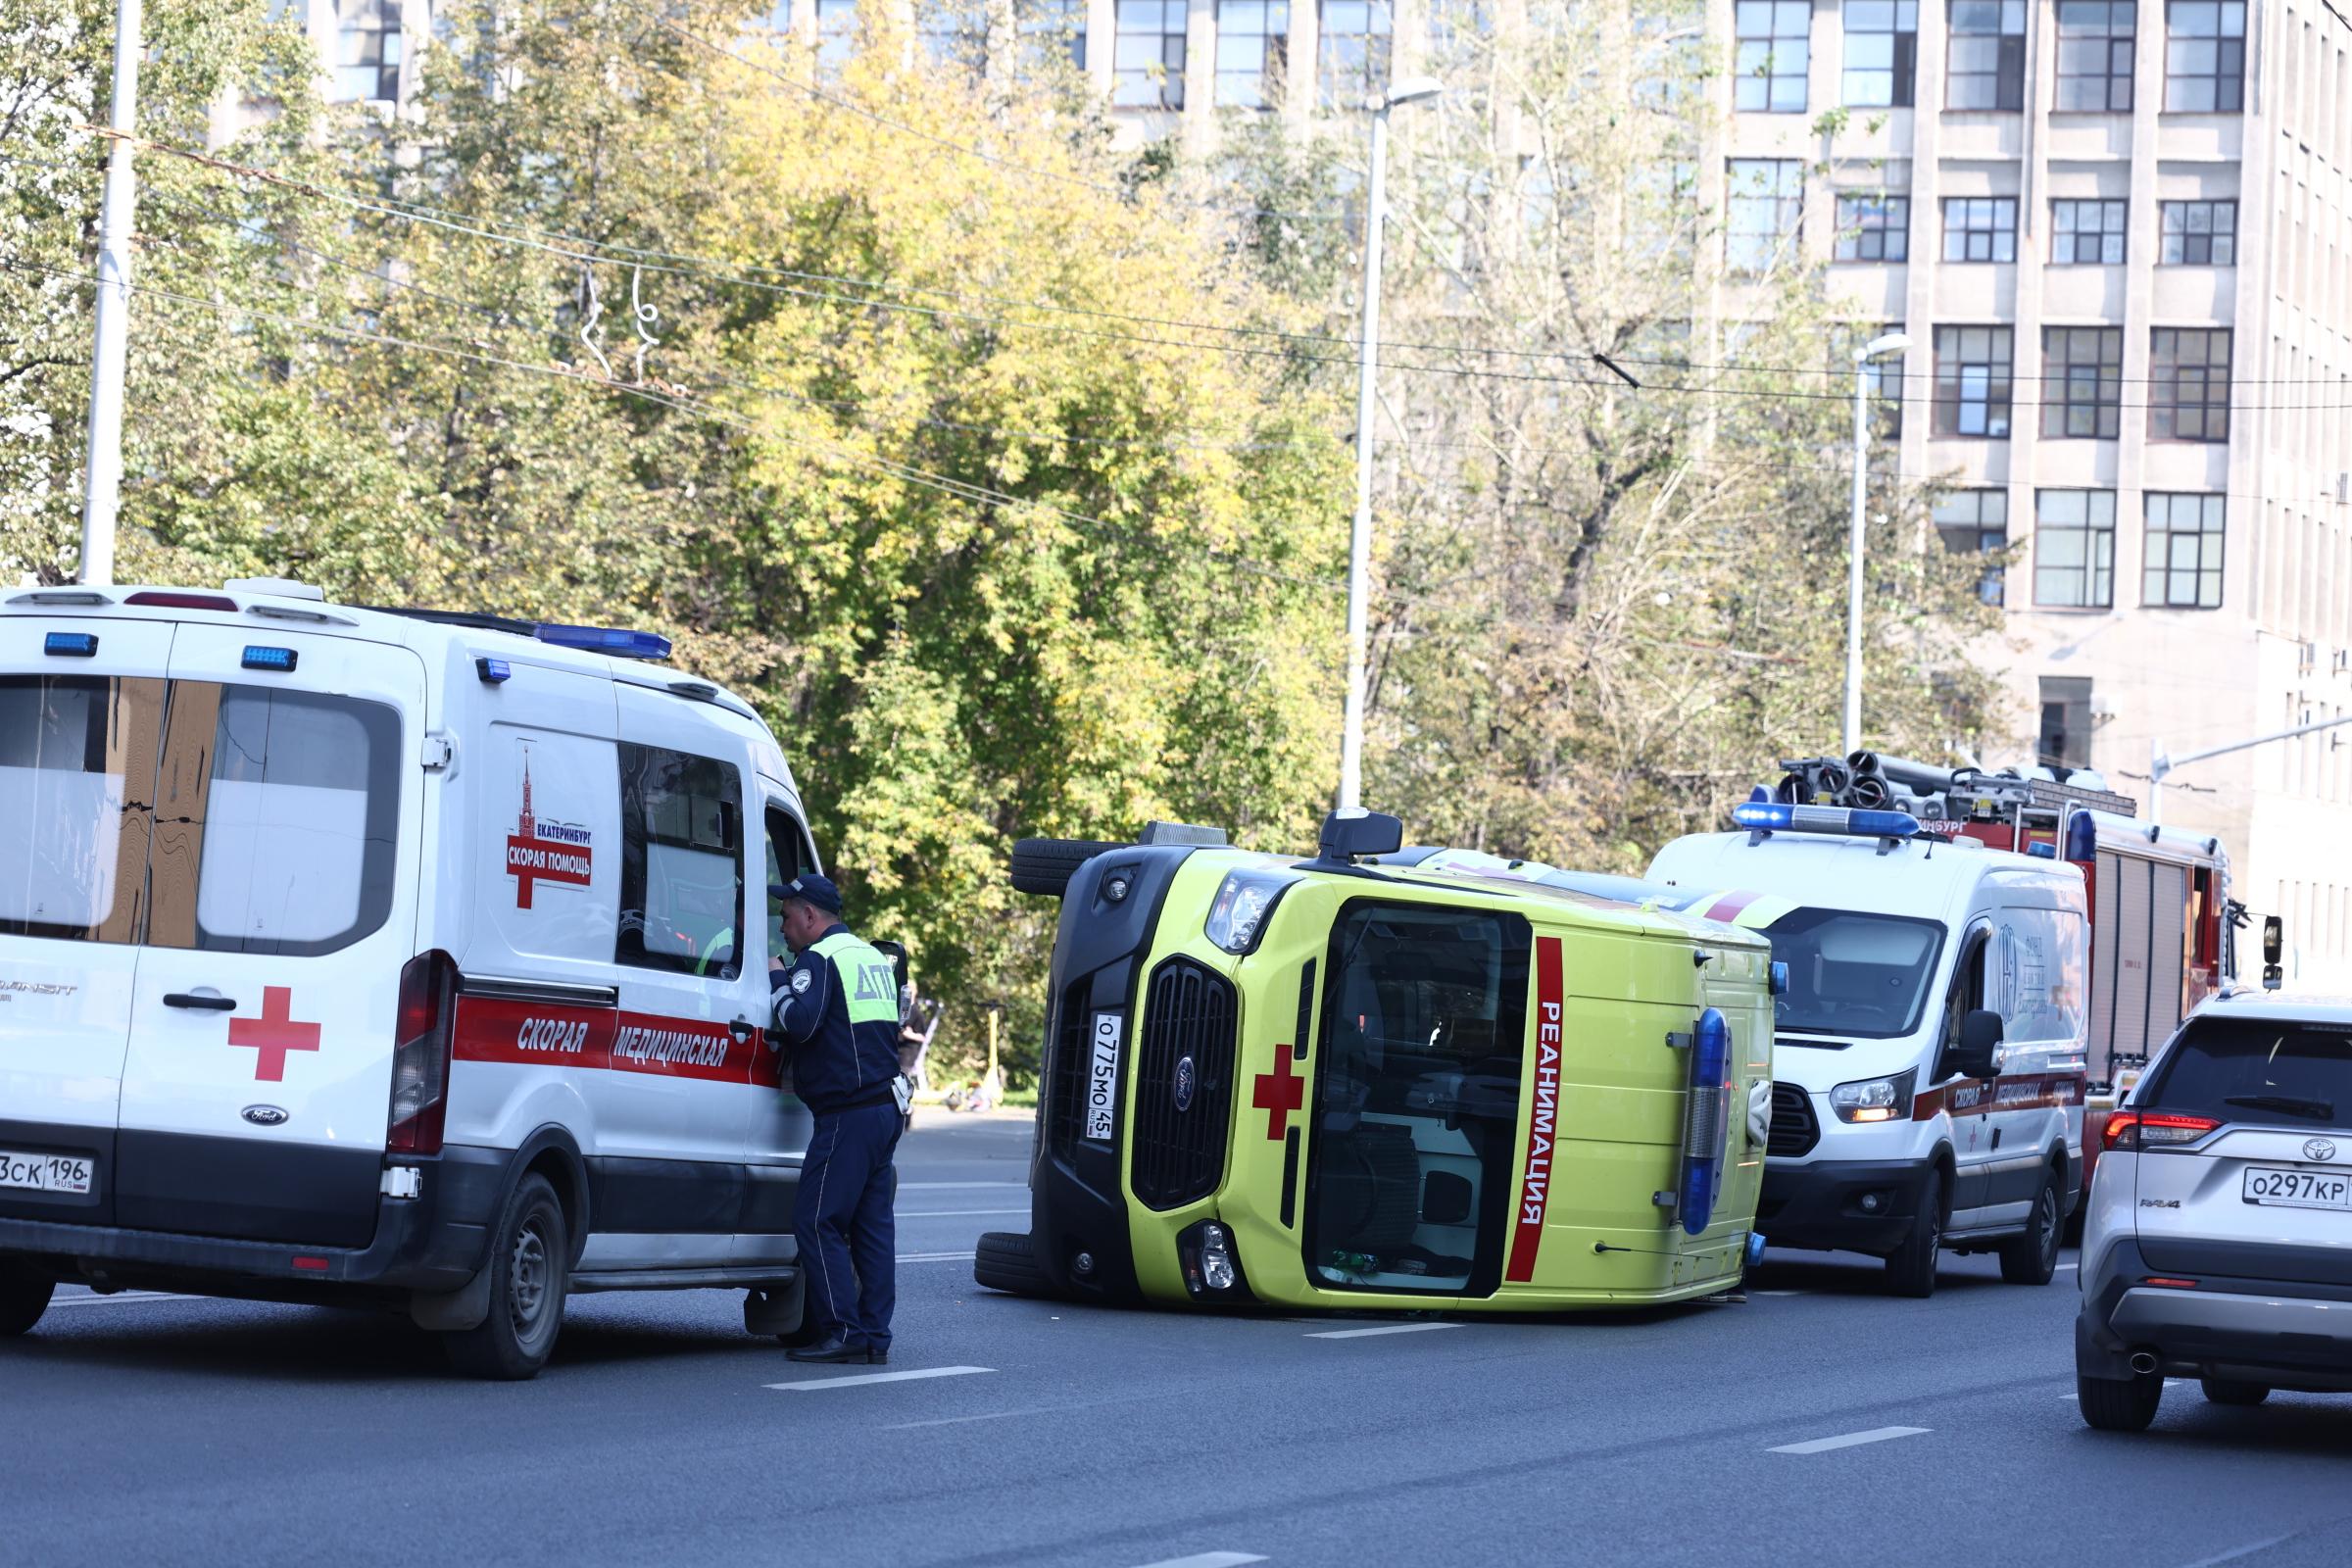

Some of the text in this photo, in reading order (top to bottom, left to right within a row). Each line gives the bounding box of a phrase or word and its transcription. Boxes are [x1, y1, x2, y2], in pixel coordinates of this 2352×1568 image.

[537, 823, 591, 845] ЕКАТЕРИНБУРГ
[508, 846, 590, 878] СКОРАЯ ПОМОЩЬ
[0, 981, 78, 997] ANSIT
[516, 1017, 729, 1068] СКОРАЯ МЕДИЦИНСКАЯ
[1095, 1111, 1111, 1133] 45
[1522, 1002, 1561, 1225] РЕАНИМАЦИЯ
[48, 1158, 85, 1181] 196
[54, 1179, 73, 1190] RUS
